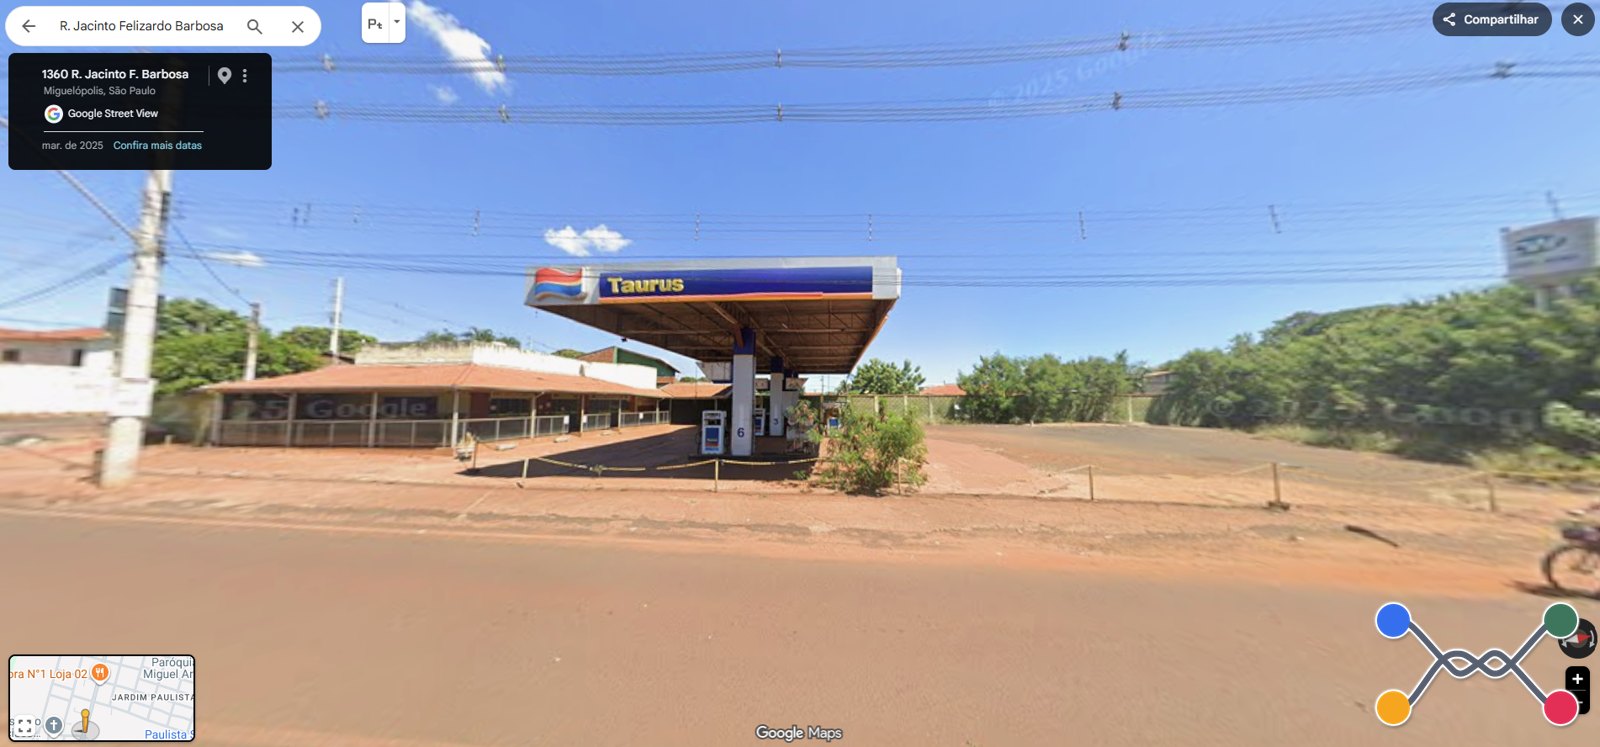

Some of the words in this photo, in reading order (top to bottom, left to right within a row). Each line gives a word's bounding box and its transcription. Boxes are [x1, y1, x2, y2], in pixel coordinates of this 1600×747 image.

[607, 277, 684, 294] Taurus
[773, 418, 779, 426] 3
[737, 427, 745, 438] 6
